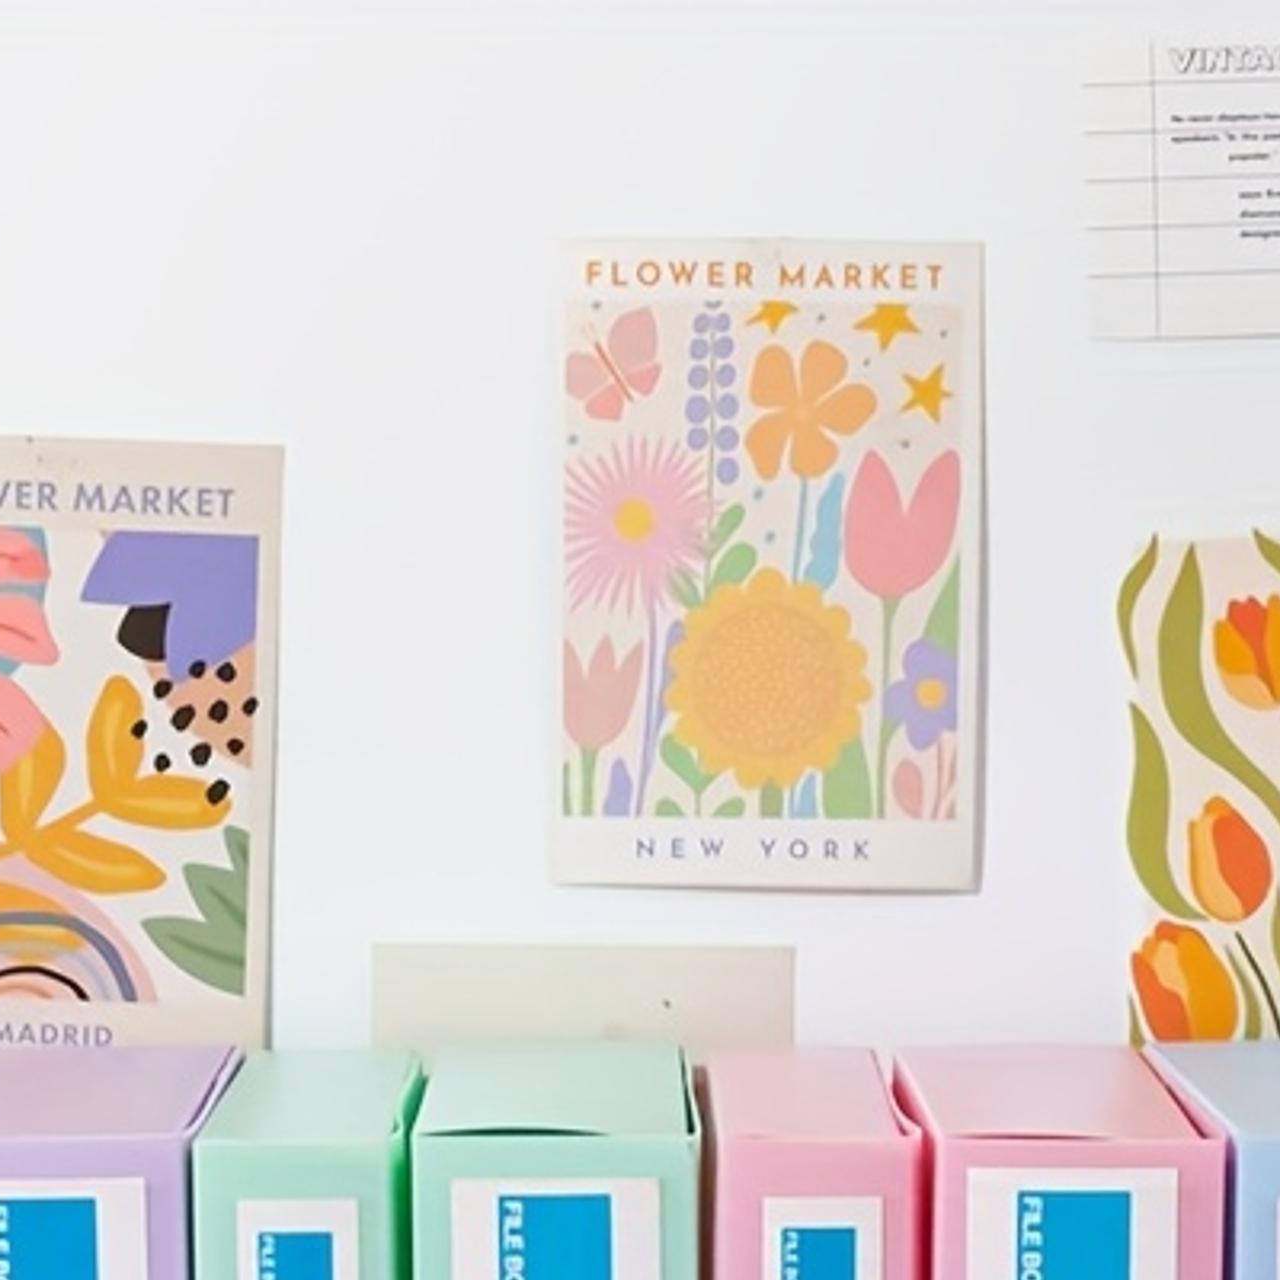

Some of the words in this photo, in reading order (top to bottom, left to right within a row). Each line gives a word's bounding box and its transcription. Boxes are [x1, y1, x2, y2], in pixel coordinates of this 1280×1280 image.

[586, 259, 754, 290] FLOWER
[778, 262, 945, 293] MARKET
[73, 481, 236, 519] MARKET
[636, 838, 724, 860] NEW
[760, 839, 872, 861] YORK
[503, 1200, 526, 1251] FILE
[1021, 1196, 1043, 1247] FILE
